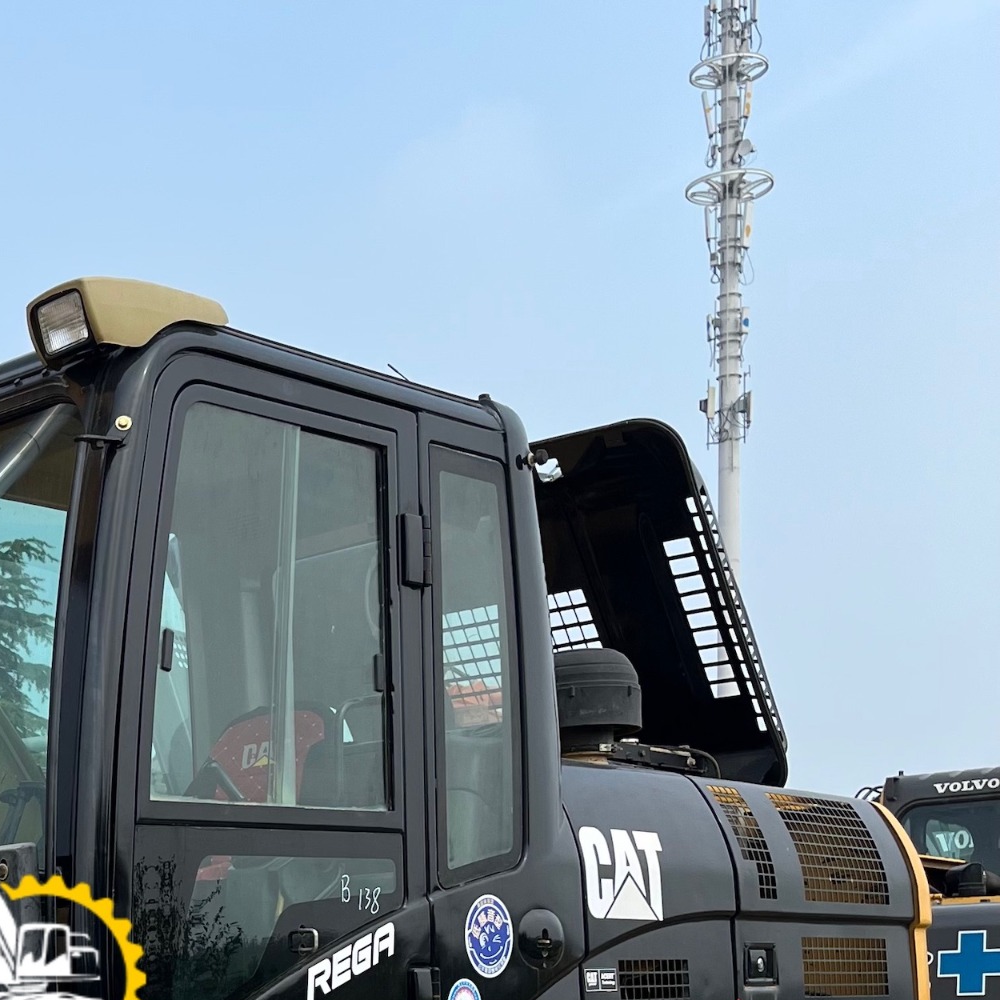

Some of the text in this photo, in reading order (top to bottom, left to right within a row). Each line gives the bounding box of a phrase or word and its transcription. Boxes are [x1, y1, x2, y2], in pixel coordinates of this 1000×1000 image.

[242, 741, 277, 769] CA
[933, 777, 1000, 794] VOLVO
[578, 825, 663, 921] CAT
[341, 874, 381, 914] B 138
